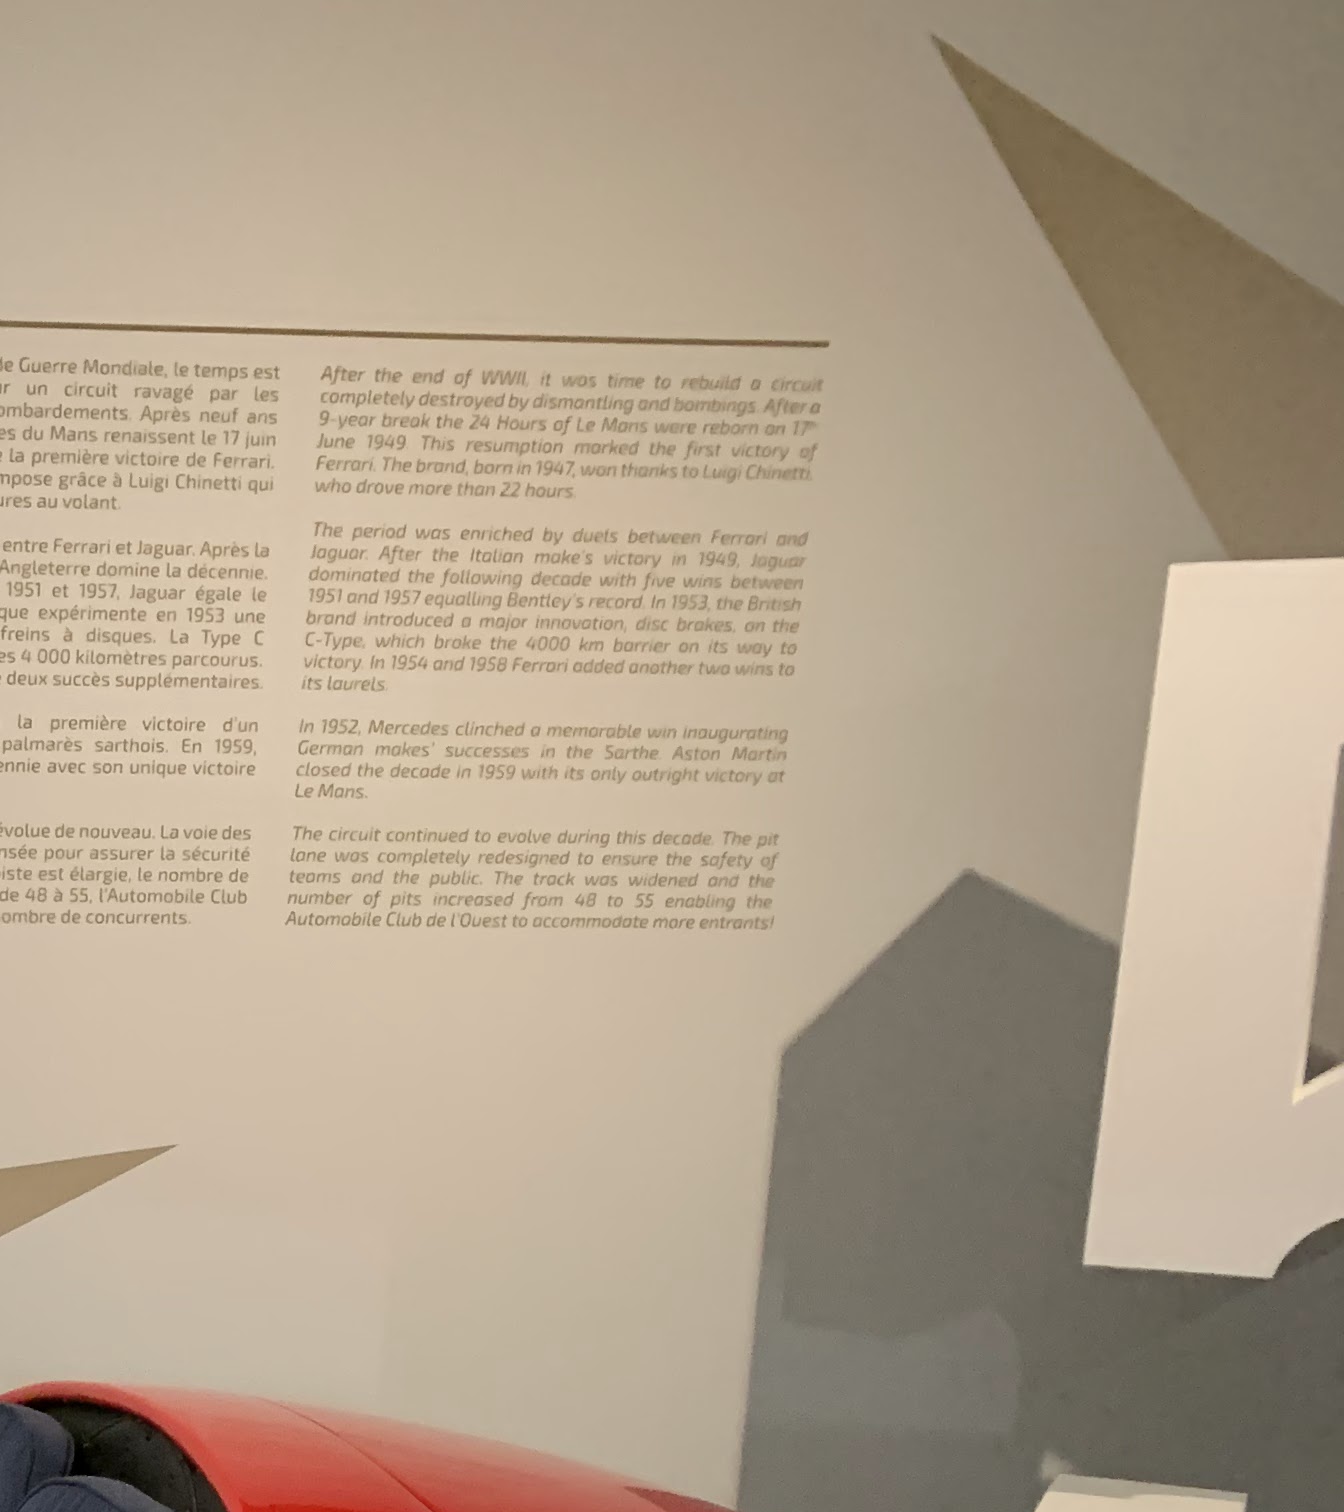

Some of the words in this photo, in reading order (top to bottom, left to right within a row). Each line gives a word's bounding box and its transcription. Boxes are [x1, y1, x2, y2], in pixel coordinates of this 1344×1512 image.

[18, 356, 77, 374] Guerre
[82, 358, 168, 378] Mondiale,
[173, 361, 189, 377] le
[192, 362, 248, 382] temps
[252, 364, 280, 380] est
[138, 404, 191, 425] Après
[198, 406, 239, 423] neuf
[246, 411, 277, 424] ans
[21, 425, 44, 441] du
[49, 425, 98, 442] Mans
[103, 427, 195, 445] renaissent
[200, 429, 217, 445] le
[222, 429, 240, 445] 17
[244, 430, 276, 450] juin
[8, 447, 25, 463] la
[30, 447, 109, 469] première
[114, 449, 179, 467] victoire
[185, 451, 207, 468] de
[212, 451, 274, 469] Ferrari.
[35, 496, 58, 509] au
[61, 492, 120, 510] volant.
[311, 521, 344, 538] The
[350, 523, 407, 542] period
[413, 527, 452, 540] was
[458, 525, 534, 542] enriched
[541, 526, 564, 546] by
[571, 527, 619, 543] duels
[626, 528, 702, 545] between
[709, 528, 768, 546] Ferrari
[775, 530, 809, 547] and
[95, 560, 160, 578] domine
[165, 562, 181, 578] la
[186, 562, 267, 580] décennie.
[306, 565, 401, 583] dominated
[405, 568, 435, 583] the
[439, 567, 523, 590] following
[529, 570, 592, 587] decade
[597, 571, 637, 587] with
[642, 571, 676, 589] five
[681, 573, 723, 588] wins
[729, 573, 804, 590] between
[37, 603, 147, 625] expérimente
[155, 609, 177, 622] en
[185, 606, 224, 623] 1953
[233, 611, 266, 624] une
[5, 670, 48, 686] deux
[52, 670, 110, 687] succès
[114, 671, 263, 693] supplémentaires.
[16, 713, 33, 729] la
[49, 713, 127, 734] première
[141, 715, 206, 732] victoire
[222, 716, 258, 733] d'un
[297, 718, 315, 733] In
[366, 719, 450, 736] Mercedes
[453, 720, 525, 737] clinched
[528, 725, 541, 737] a
[545, 722, 642, 739] memorable
[645, 724, 678, 739] win
[681, 725, 789, 745] inaugurating
[1, 735, 83, 755] palmarès
[93, 737, 168, 753] sarthois.
[180, 737, 202, 753] En
[214, 738, 256, 756] 1959,
[293, 783, 314, 798] Le
[290, 825, 323, 841] The
[327, 826, 381, 842] circuit
[384, 827, 469, 843] continued
[472, 828, 492, 843] to
[495, 828, 552, 844] evolve
[555, 828, 611, 848] during
[614, 829, 647, 845] this
[720, 830, 753, 846] The
[755, 831, 779, 849] pit
[43, 847, 84, 863] pour
[88, 848, 155, 861] assurer
[159, 845, 175, 861] la
[181, 845, 250, 862] sécurité
